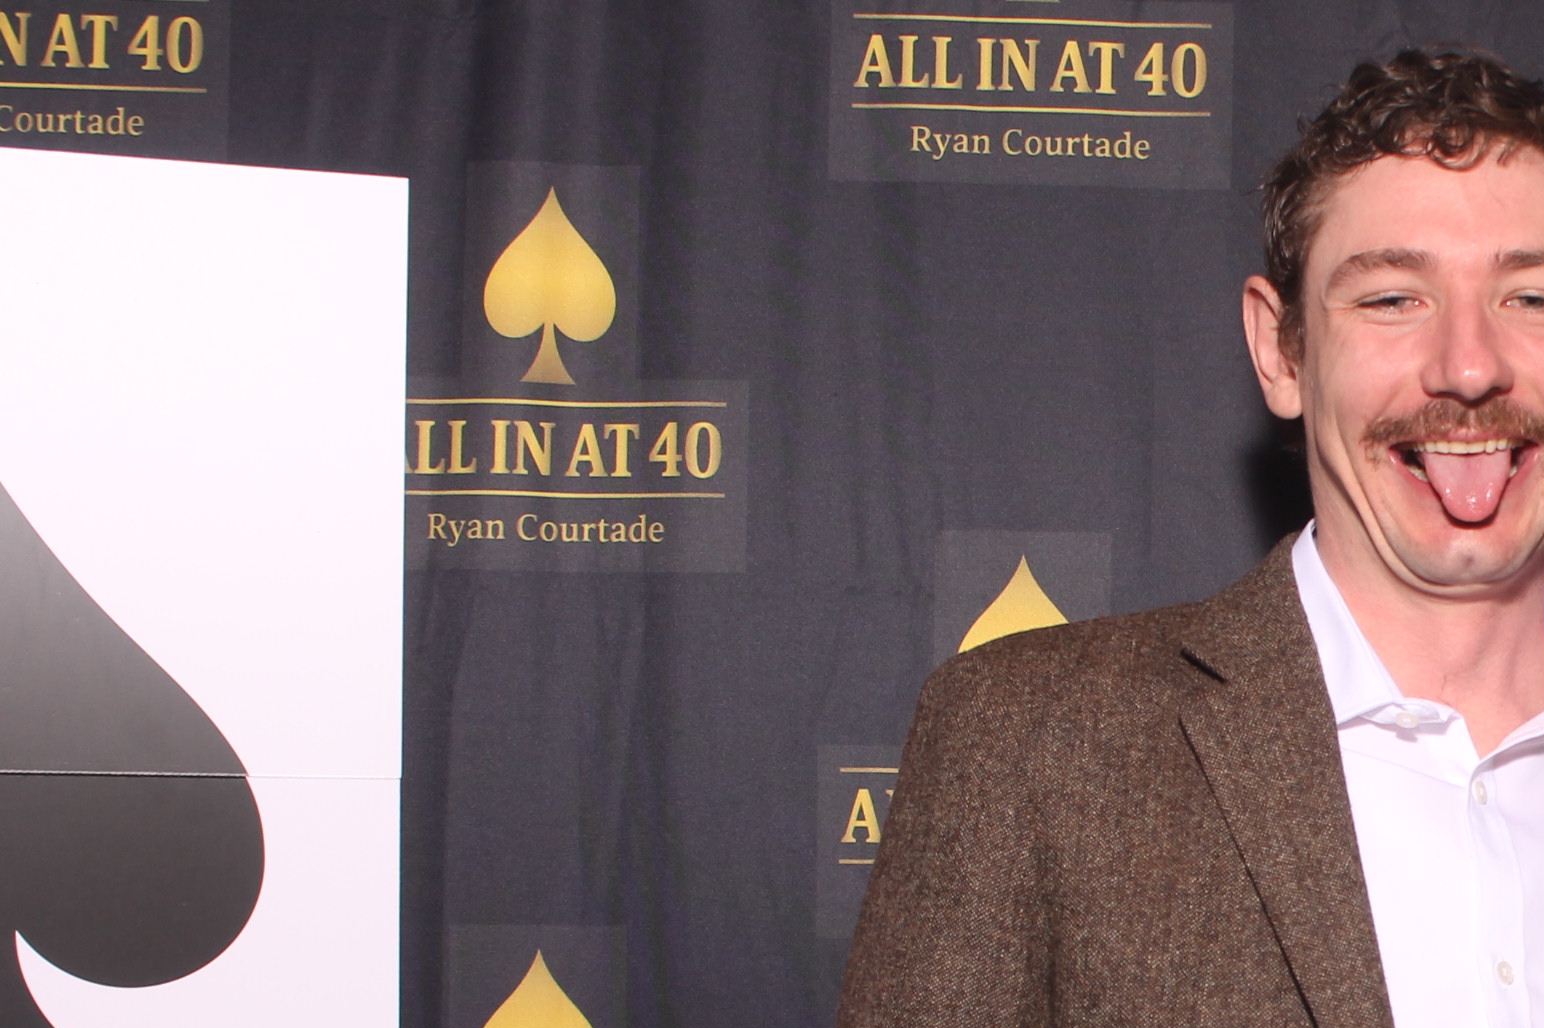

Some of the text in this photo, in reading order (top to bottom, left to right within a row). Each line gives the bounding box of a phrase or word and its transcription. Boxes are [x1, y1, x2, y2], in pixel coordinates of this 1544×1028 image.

[0, 12, 204, 74] N AT 40
[853, 34, 1208, 98] ALL IN AT 40
[0, 105, 145, 136] Courtade
[910, 125, 1151, 160] Ryan Courtade
[405, 419, 723, 479] LL IN AT 40
[426, 512, 666, 547] Ryan Courtade
